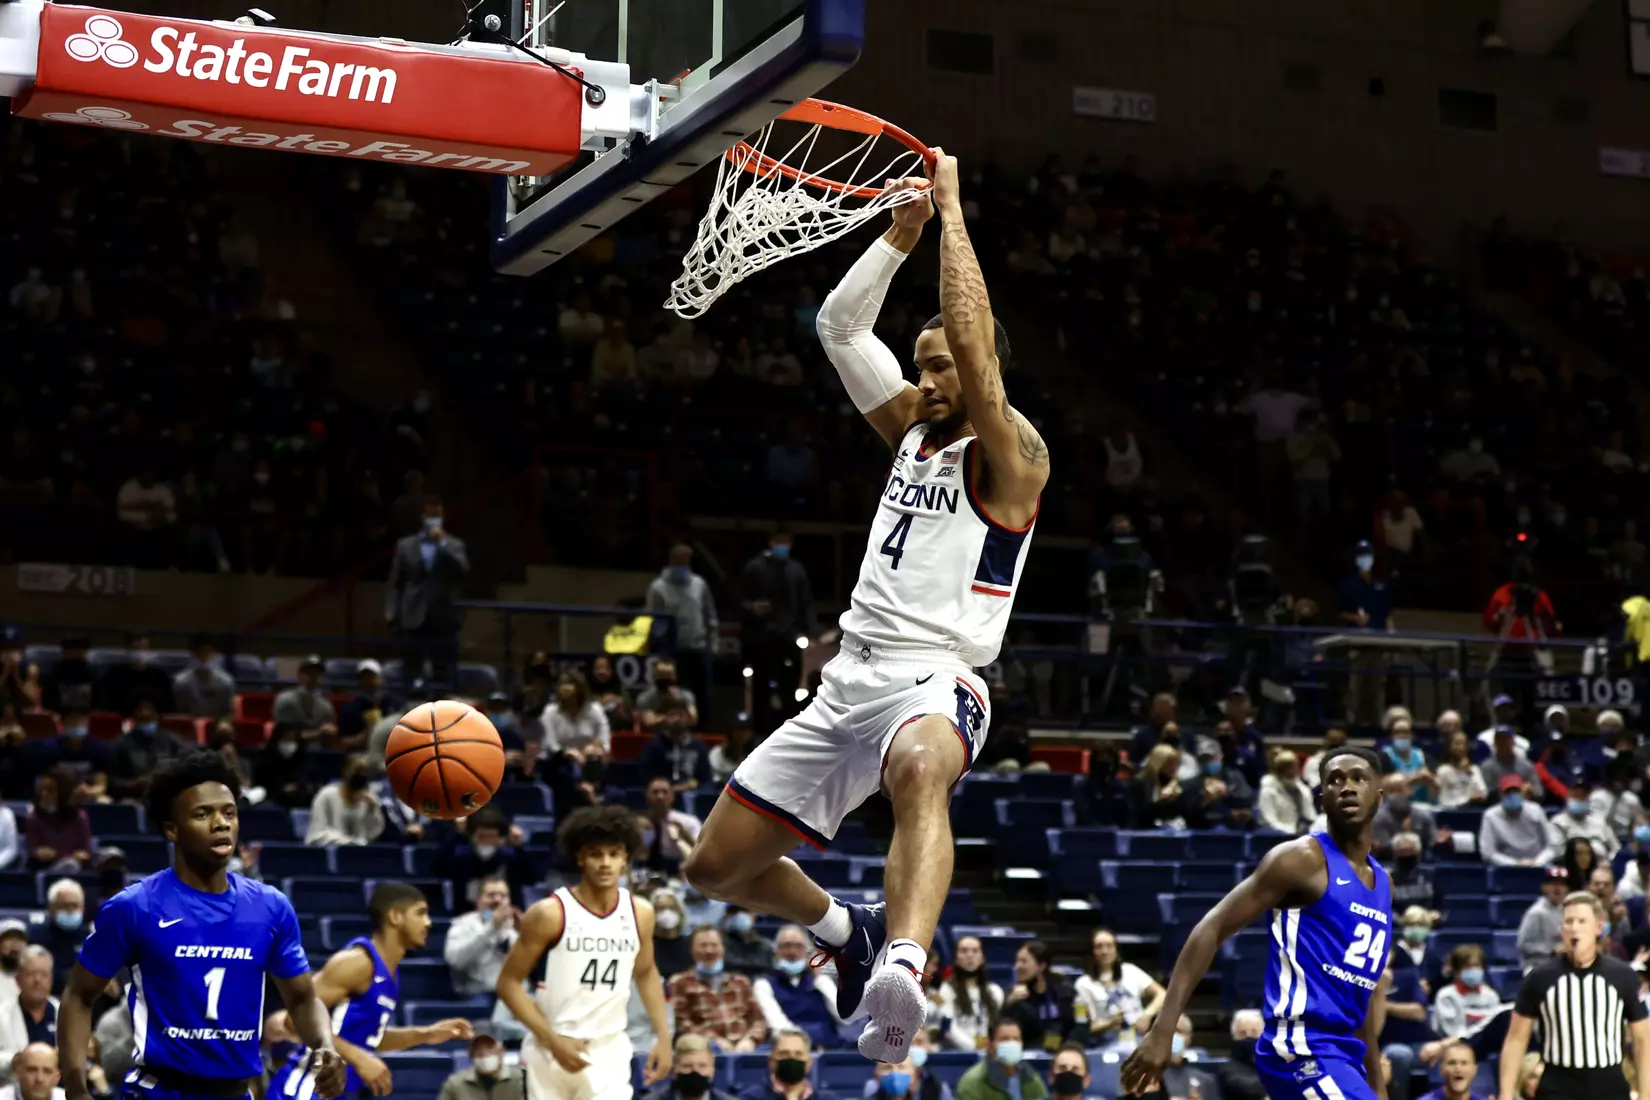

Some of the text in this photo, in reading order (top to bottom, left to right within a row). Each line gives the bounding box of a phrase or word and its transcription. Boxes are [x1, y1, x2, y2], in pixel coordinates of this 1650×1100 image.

[880, 513, 914, 570] 4
[1536, 677, 1635, 706] SEC 109
[174, 945, 254, 960] CENTRAL
[566, 937, 636, 953] UCONN
[1342, 922, 1386, 973] 24
[580, 959, 618, 991] 44
[203, 967, 227, 1020] 1
